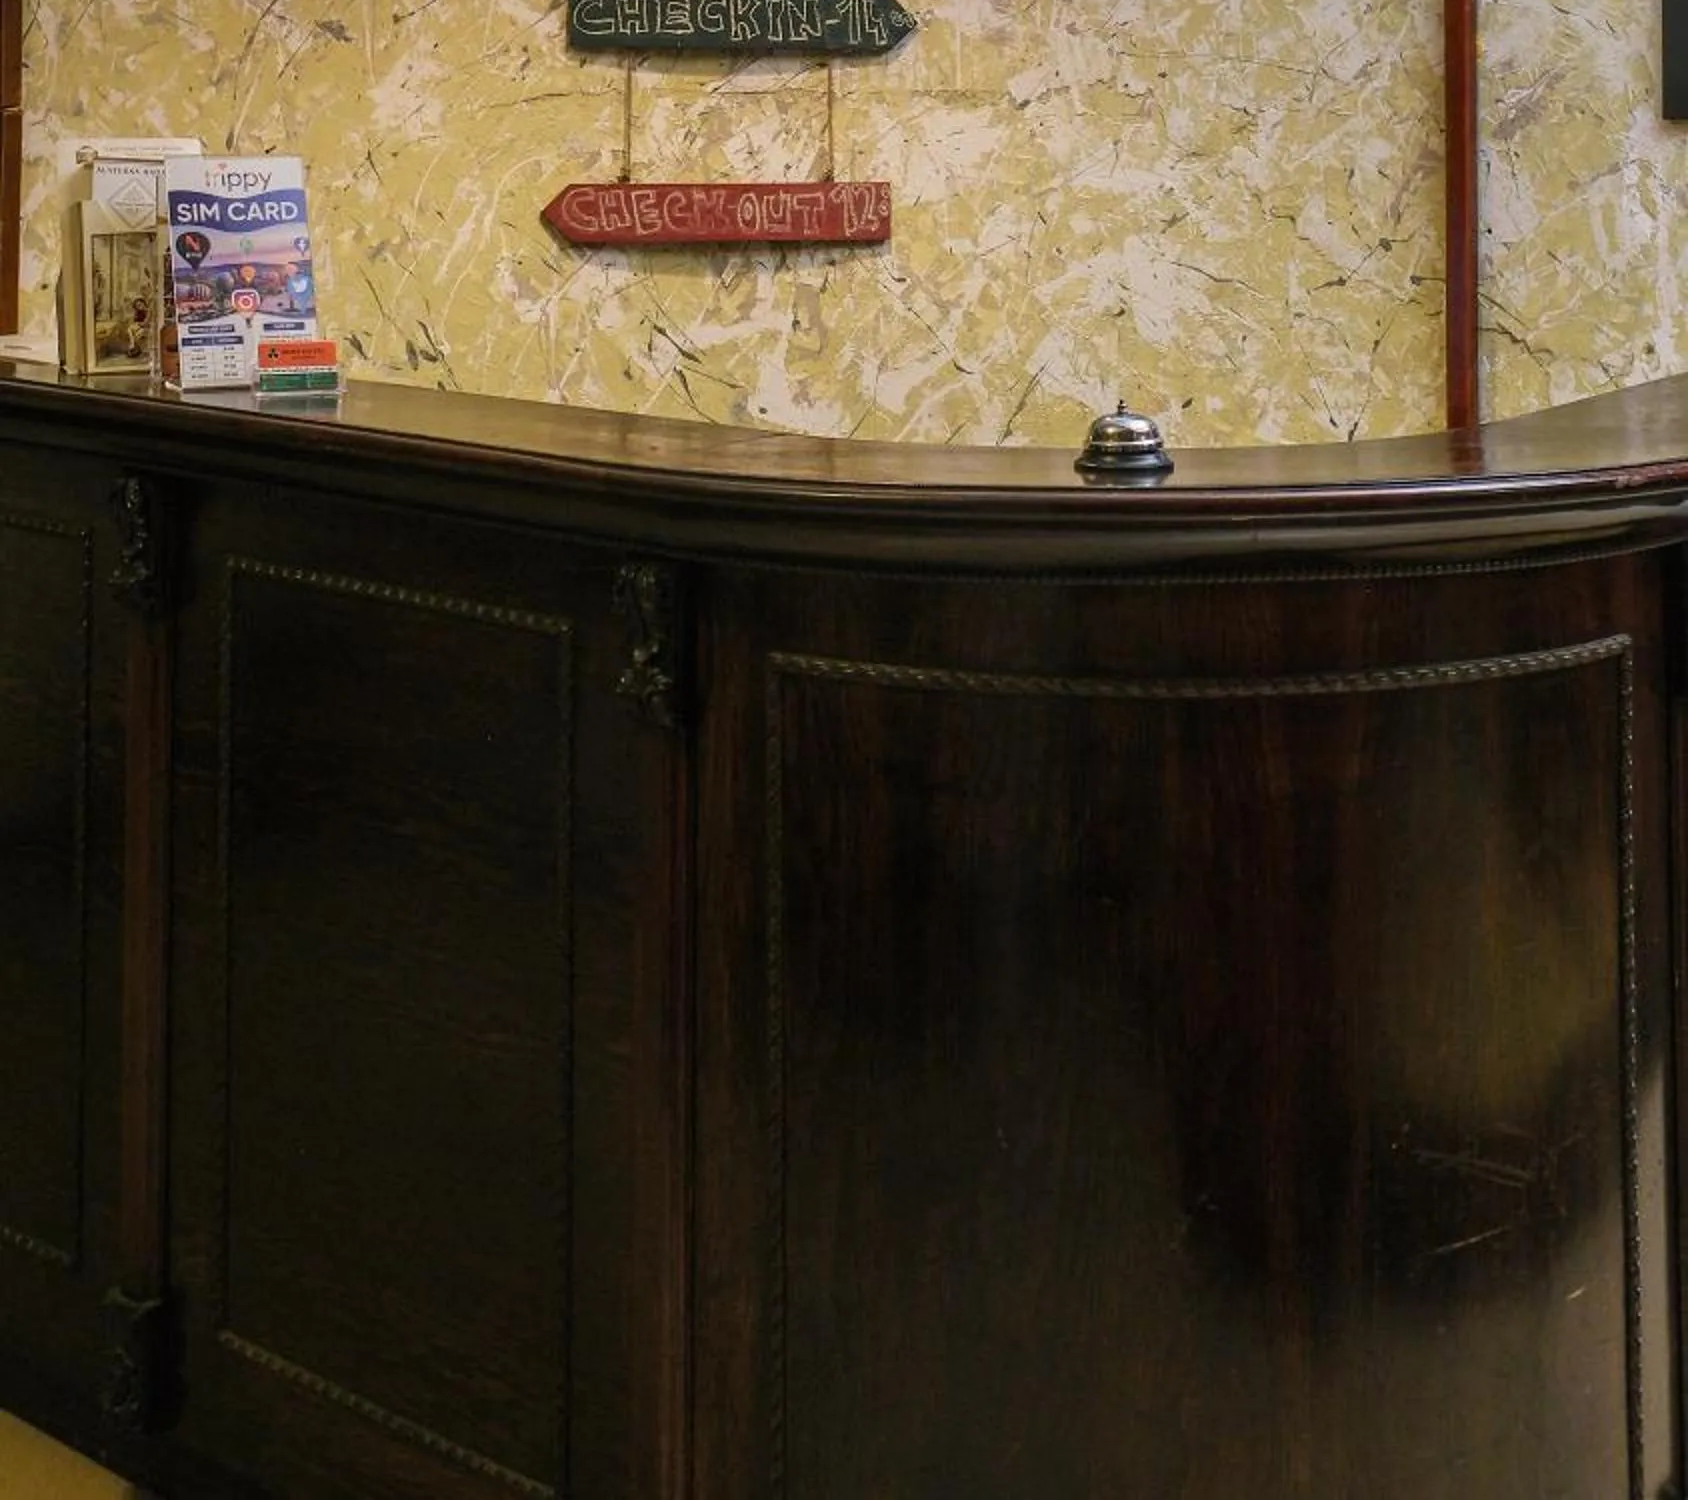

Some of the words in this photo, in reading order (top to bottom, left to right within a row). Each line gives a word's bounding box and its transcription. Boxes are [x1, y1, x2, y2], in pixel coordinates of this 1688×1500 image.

[205, 164, 272, 192] trippy
[177, 202, 220, 222] SIM
[227, 201, 298, 221] CARD
